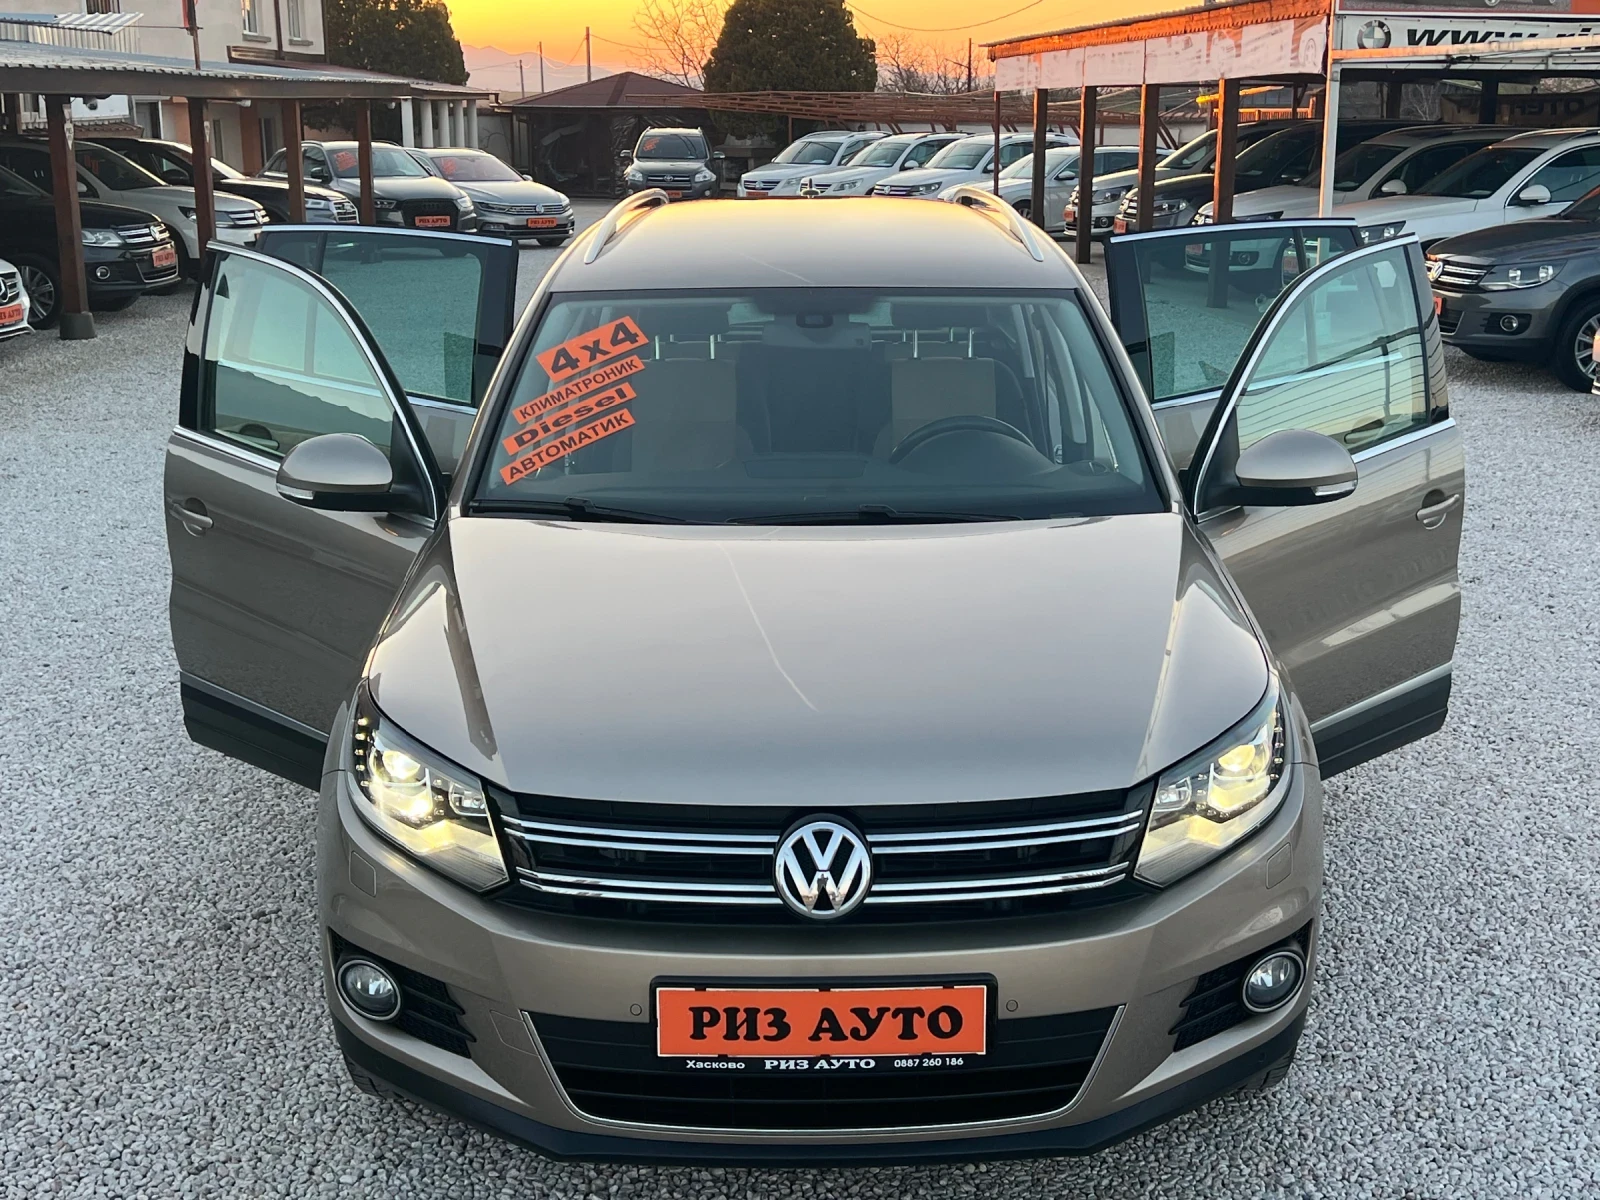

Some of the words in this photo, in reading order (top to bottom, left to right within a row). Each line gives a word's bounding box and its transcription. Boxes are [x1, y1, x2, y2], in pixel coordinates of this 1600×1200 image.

[551, 322, 639, 374] 4x4
[519, 360, 639, 419] КЛИМАТРОНИК
[514, 387, 628, 448] Diesel
[509, 412, 629, 480] АВТОМАТИК
[688, 1006, 792, 1042] РИЗ
[807, 1005, 964, 1042] АУТО
[686, 1059, 746, 1070] Хасково
[764, 1059, 810, 1070] РИЗ
[813, 1058, 877, 1070] АУТО
[894, 1059, 920, 1068] 0887
[922, 1058, 942, 1067] 260
[945, 1057, 964, 1066] 186
